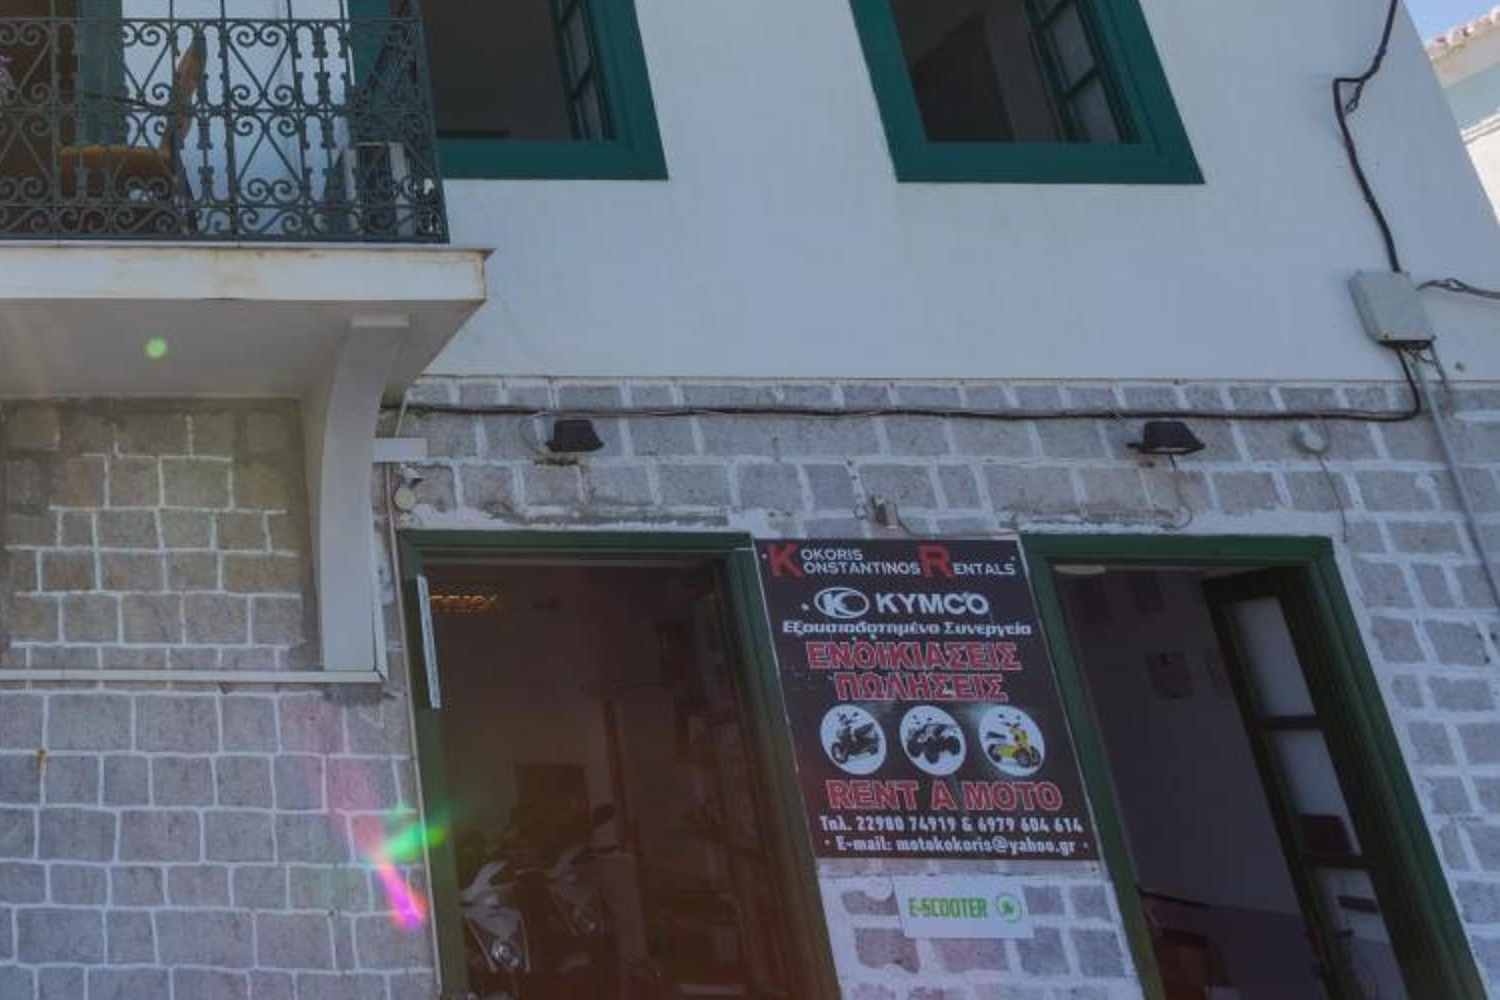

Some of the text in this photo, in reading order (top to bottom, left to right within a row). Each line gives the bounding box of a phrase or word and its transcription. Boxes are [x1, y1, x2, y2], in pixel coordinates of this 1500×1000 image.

[875, 592, 989, 615] KYMCO
[805, 641, 1023, 671] ΕΝΟΙΚΙΑΣΕΙΣ
[834, 672, 1009, 701] ΠΩΛΗΣΕΙΣ
[825, 780, 1062, 811] RENT A MOTO
[835, 835, 893, 851] E-mail:
[908, 897, 989, 919] E-SCOOTER
